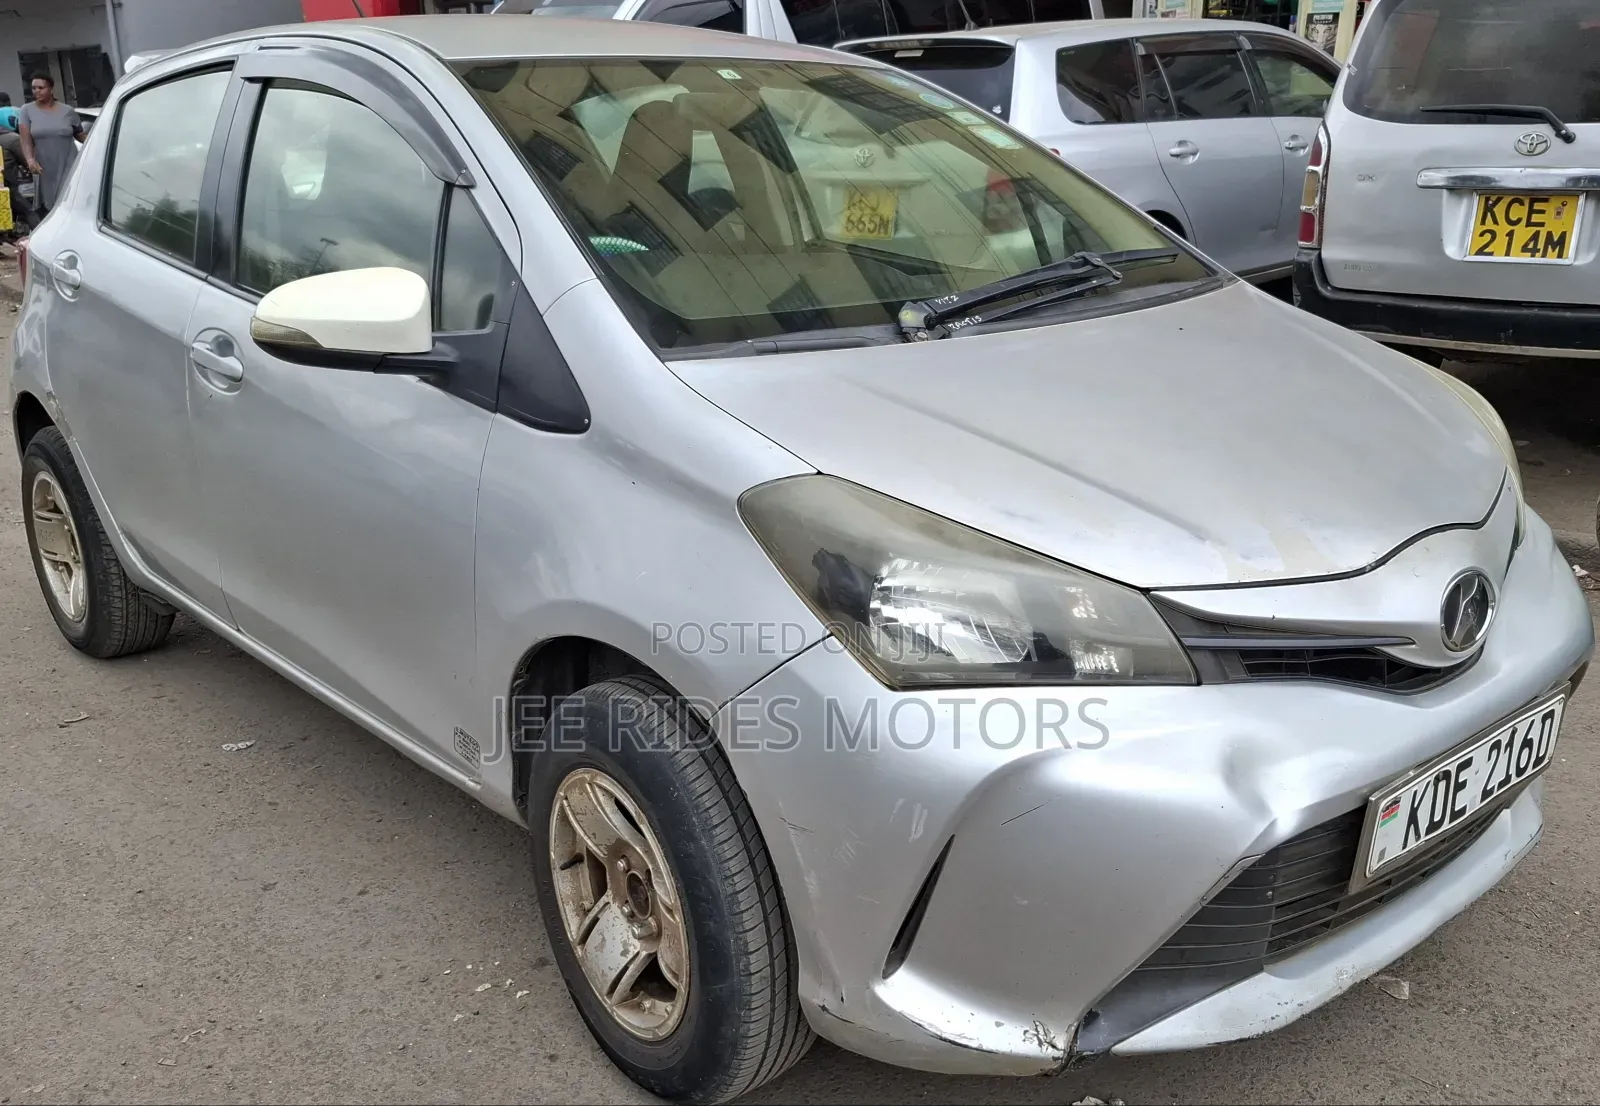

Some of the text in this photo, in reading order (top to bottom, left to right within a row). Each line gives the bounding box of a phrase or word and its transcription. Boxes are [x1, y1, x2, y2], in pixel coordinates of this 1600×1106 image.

[1480, 196, 1550, 228] KCE
[1474, 228, 1568, 259] 214M
[1402, 708, 1555, 850] KDE 216D
